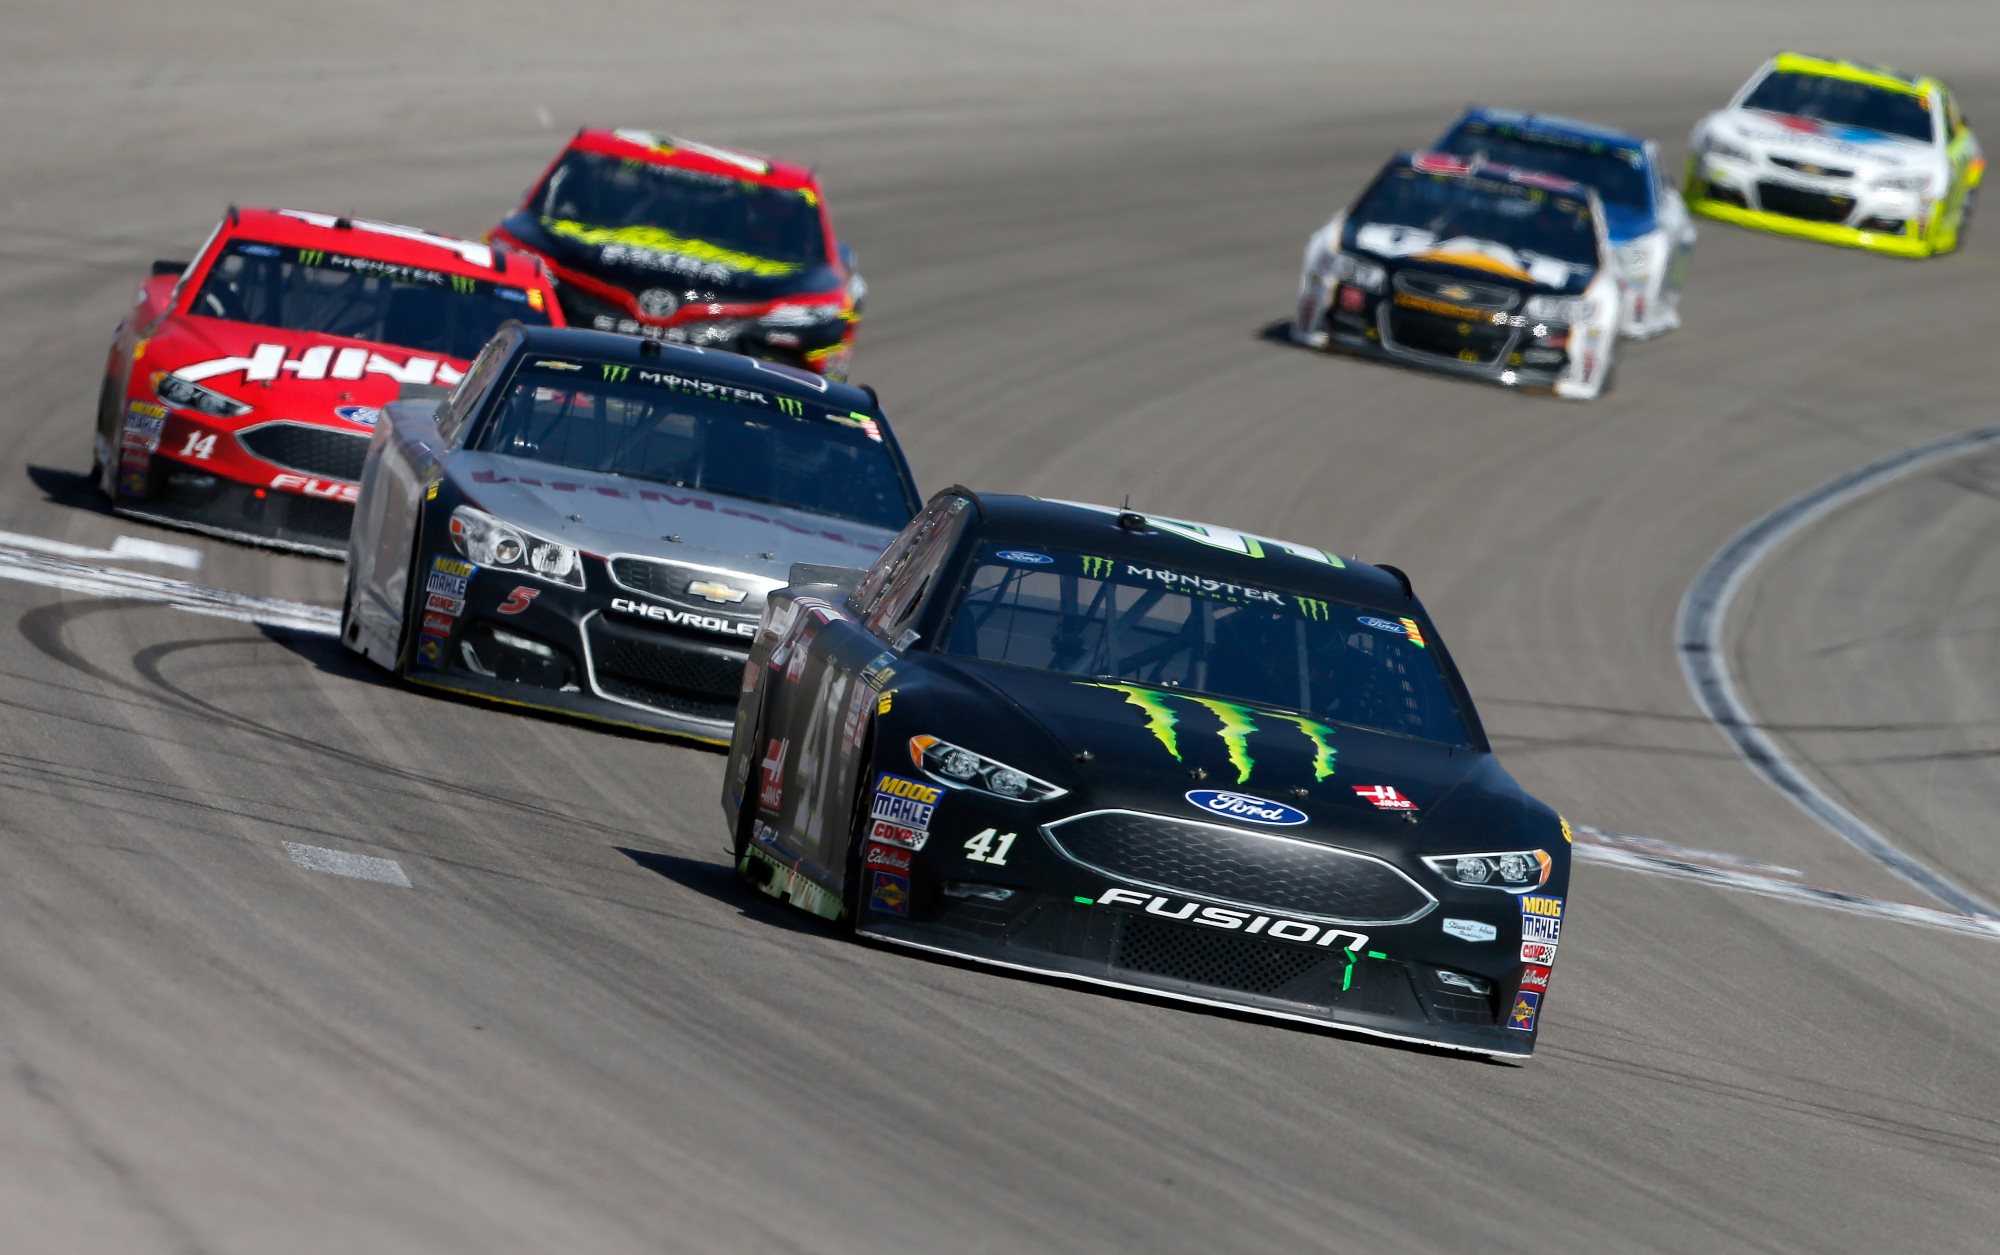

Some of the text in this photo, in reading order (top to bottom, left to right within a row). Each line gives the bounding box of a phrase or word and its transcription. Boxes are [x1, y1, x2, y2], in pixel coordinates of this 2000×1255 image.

[640, 371, 768, 404] MONSTER
[180, 431, 218, 459] 14
[270, 474, 361, 502] FUS
[1127, 565, 1286, 605] MONSTER
[497, 586, 541, 615] 5
[611, 598, 758, 637] CHEVROLE
[876, 776, 942, 804] MOOG
[873, 794, 931, 825] MAHLE
[1209, 793, 1284, 820] Ford
[963, 828, 1017, 866] 41
[1097, 888, 1370, 951] FUSION
[1522, 896, 1562, 917] MOOG
[1523, 916, 1559, 940] MAHLE
